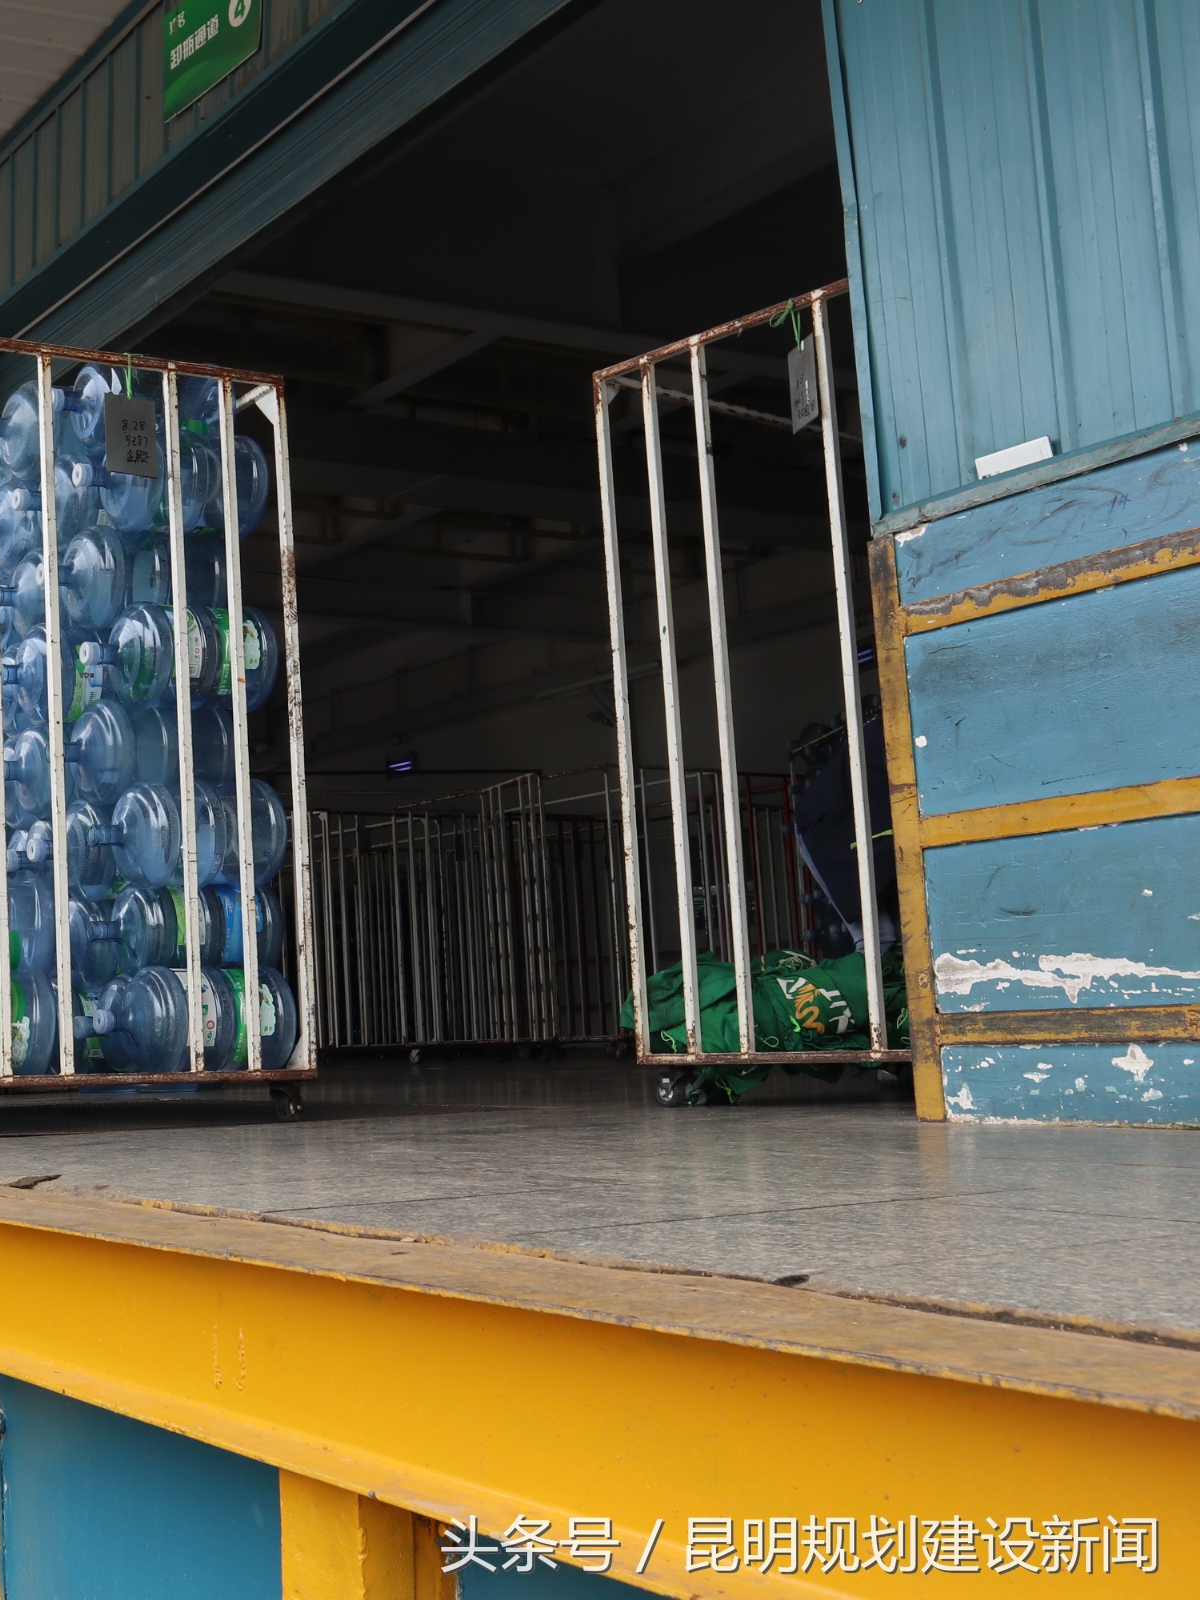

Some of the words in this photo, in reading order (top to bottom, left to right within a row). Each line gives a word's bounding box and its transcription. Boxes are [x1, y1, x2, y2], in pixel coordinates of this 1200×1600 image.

[170, 14, 219, 70] 卸瓶通道
[121, 419, 146, 431] 8.28
